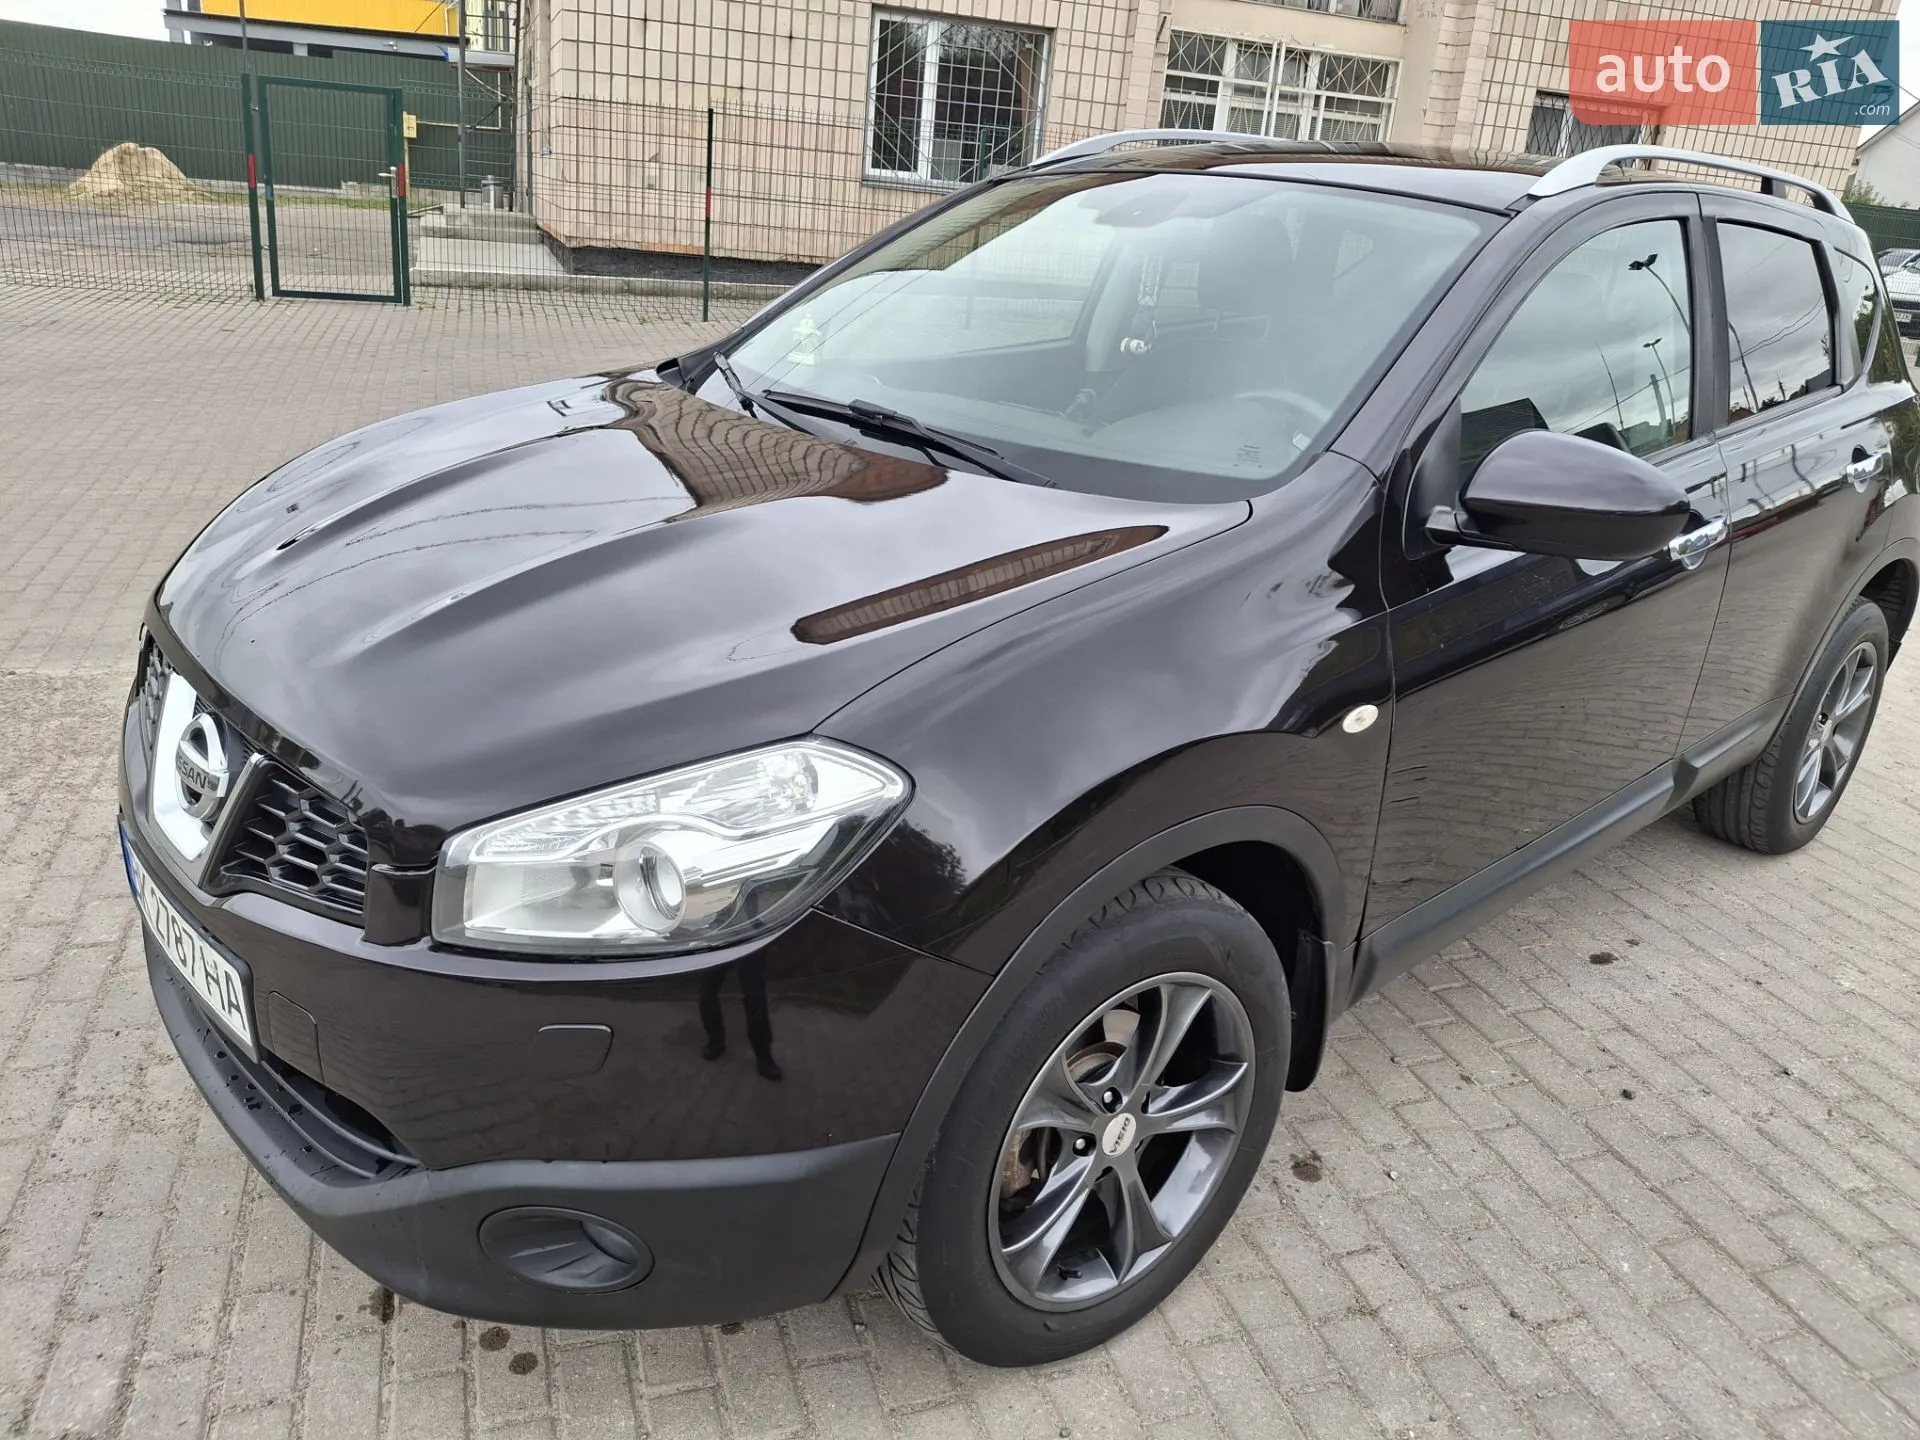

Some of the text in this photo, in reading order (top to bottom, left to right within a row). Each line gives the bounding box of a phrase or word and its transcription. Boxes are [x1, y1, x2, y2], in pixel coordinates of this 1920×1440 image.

[176, 751, 207, 789] ISSAN
[150, 885, 196, 978] 2787
[199, 944, 248, 1033] HA
